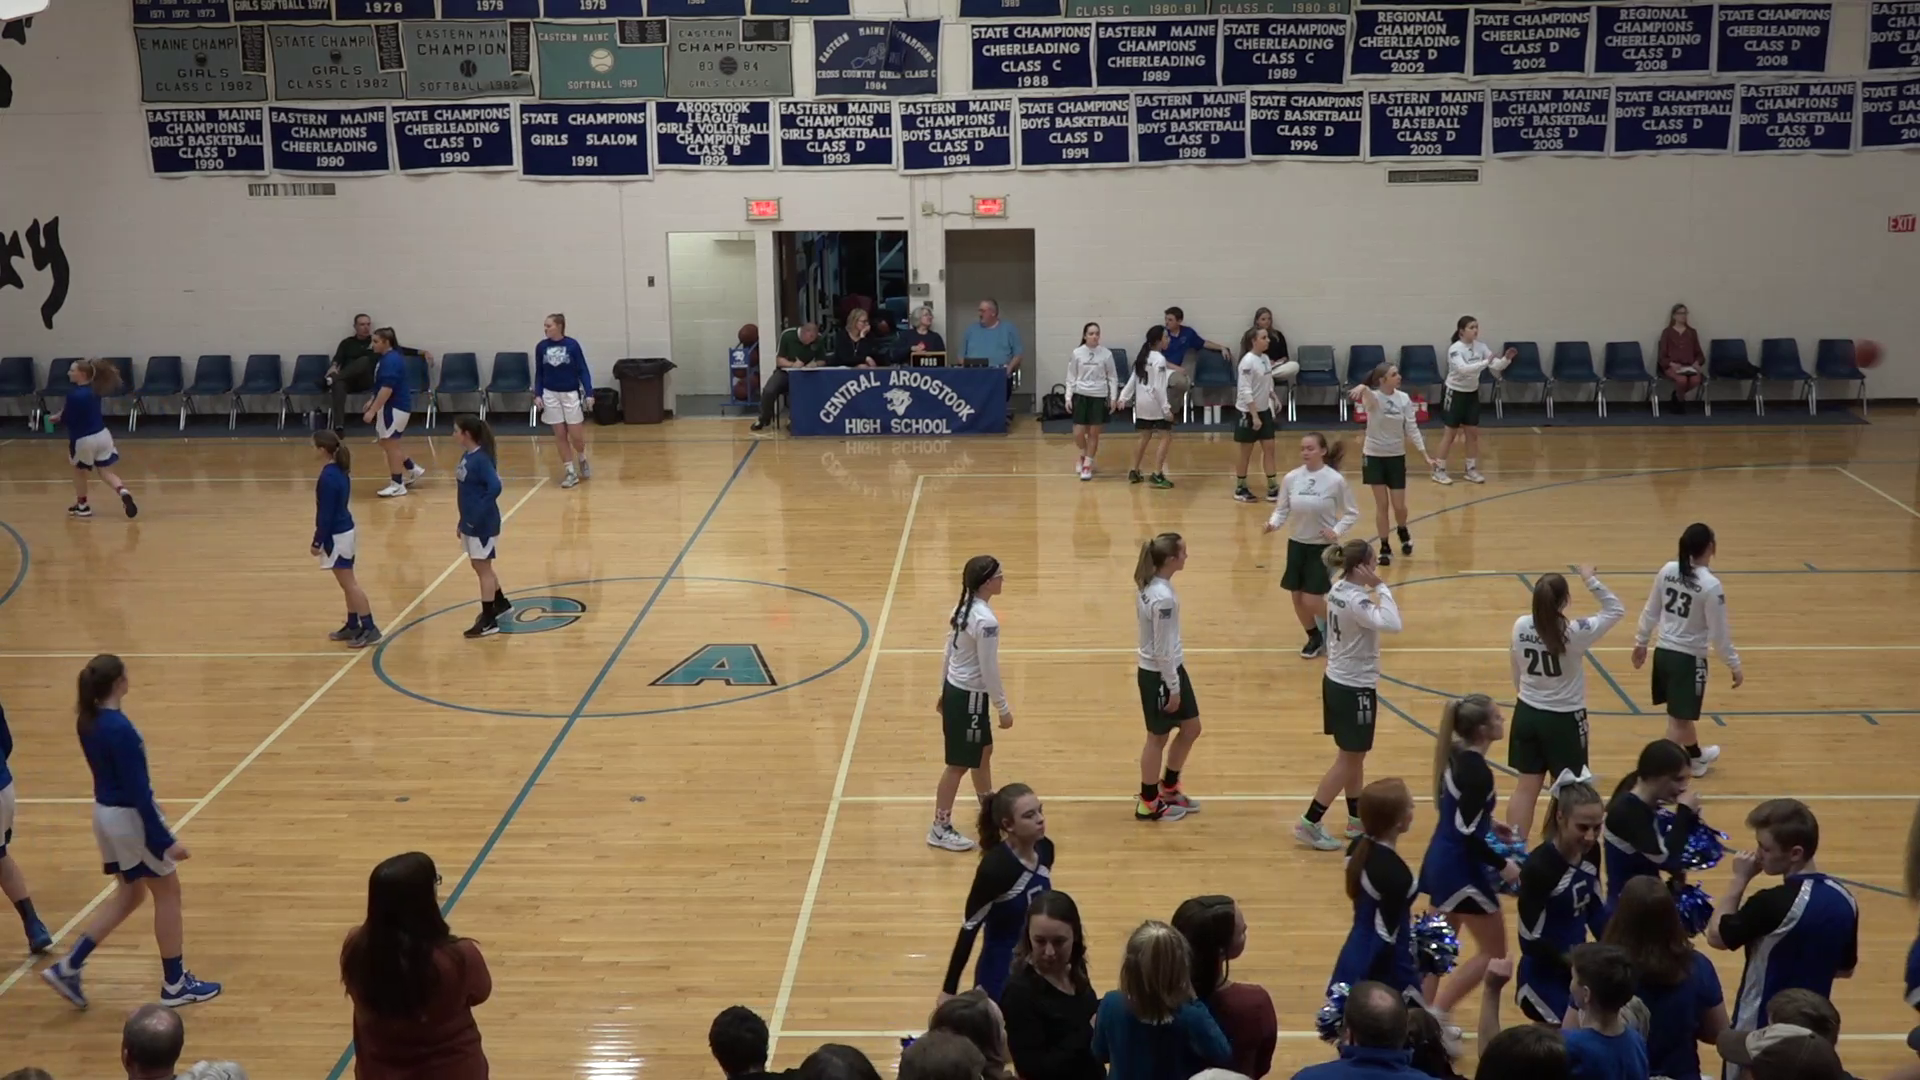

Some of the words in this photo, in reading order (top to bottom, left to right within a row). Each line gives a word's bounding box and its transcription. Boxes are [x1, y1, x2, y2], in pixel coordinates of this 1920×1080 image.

[365, 2, 403, 13] 1978
[1076, 6, 1114, 16] CLASS
[1123, 5, 1130, 15] C
[1220, 3, 1259, 14] CLASS
[1267, 3, 1274, 13] C
[1872, 3, 1920, 15] EASTER
[1378, 12, 1443, 23] REGIONAL
[1620, 9, 1688, 20] REGIONAL
[972, 27, 1009, 39] STATE
[1014, 26, 1090, 38] CHAMPIONS
[1099, 26, 1156, 38] EASTERN
[1170, 25, 1216, 36] MAINE
[1374, 25, 1447, 36] CHAMPION
[1614, 22, 1694, 33] CHAMPIONS
[417, 29, 473, 40] EASTERN
[480, 28, 508, 39] MAIN
[538, 33, 577, 42] EASTERN
[583, 33, 608, 42] MAINE
[1604, 34, 1701, 46] CHEERLEADING
[1871, 30, 1902, 43] BOYS
[152, 39, 188, 50] MAINE
[192, 38, 238, 50] CHAMPI
[276, 36, 315, 47] STATE
[322, 35, 375, 47] CHAMPI
[819, 32, 850, 63] EASTERN
[858, 26, 885, 36] MAINE
[1118, 40, 1196, 52] CHAMPIONS
[1359, 36, 1460, 48] CHEERLEADING
[417, 43, 507, 56] CHAMPION
[982, 43, 1080, 56] CHEERLEADING
[1380, 49, 1419, 60] CLASS
[1428, 49, 1437, 59] D
[1622, 48, 1662, 59] CLASS
[1672, 47, 1682, 58] D
[699, 62, 714, 71] 83
[744, 62, 758, 71] 84
[1001, 61, 1041, 72] CLASS
[1053, 60, 1061, 71] C
[1108, 55, 1205, 68] CHEERLEADING
[1391, 62, 1425, 73] 2002
[1635, 60, 1668, 71] 2008
[177, 68, 229, 78] GIRLS
[312, 66, 362, 75] GIRLS
[817, 70, 840, 78] CROSS
[842, 70, 876, 78] COUNTRY
[905, 70, 928, 78] CLASS
[1142, 71, 1170, 82] 1989
[156, 82, 198, 91] CLASS
[205, 82, 213, 91] C
[220, 81, 252, 91] 1982
[287, 80, 332, 89] CLASS
[340, 80, 347, 88] C
[356, 79, 388, 88] 1982
[420, 81, 483, 92] SOFTBALL
[489, 80, 519, 91] 1982
[568, 81, 612, 89] SOFTBALL
[619, 80, 638, 88] 1983
[689, 80, 719, 88] GIRLS
[1018, 76, 1049, 86] 1988
[1615, 91, 1653, 102] STATE
[1658, 90, 1734, 101] CHAMPIONS
[1740, 85, 1799, 97] EASTERN
[1809, 84, 1854, 95] MAINE
[1862, 86, 1898, 98] STATE
[1136, 95, 1192, 106] EASTERN
[1203, 92, 1246, 104] MAINE
[1370, 94, 1430, 105] EASTERN
[1441, 91, 1484, 103] MAINE
[1755, 98, 1838, 110] CHAMPIONS
[676, 102, 750, 113] AROOSTOOK
[901, 103, 956, 114] EASTERN
[968, 101, 1011, 112] MAINE
[1386, 106, 1468, 117] CHAMPIONS
[1615, 106, 1645, 118] BOYS
[1652, 105, 1732, 117] BASKETBALL
[1862, 102, 1893, 112] BOYS
[148, 110, 206, 122] EASTERN
[218, 109, 262, 121] MAINE
[271, 111, 327, 124] EASTERN
[340, 111, 385, 123] MAINE
[522, 113, 558, 124] STATE
[568, 112, 645, 124] CHAMPIONS
[688, 113, 738, 124] LEAGUE
[1152, 107, 1231, 120] CHAMPIONS
[1740, 114, 1769, 124] BOYS
[1777, 112, 1852, 123] BASKETBALL
[1889, 114, 1920, 125] CLAS
[916, 115, 995, 127] CHAMPIONS
[1392, 118, 1460, 129] BASEBALL
[1642, 119, 1683, 130] CLASS
[1693, 118, 1703, 129] D
[166, 122, 245, 134] CHAMPIONS
[291, 126, 367, 139] CHAMPIONS
[657, 123, 692, 134] GIRLS
[697, 123, 770, 134] VOLLEYBALL
[1137, 123, 1167, 134] BOYS
[1170, 121, 1245, 134] BASKETBALL
[1766, 126, 1806, 136] CLASS
[1814, 125, 1824, 135] D
[530, 134, 568, 146] GIRLS
[586, 134, 638, 146] SLALOM
[676, 135, 750, 145] CHAMPIONS
[902, 130, 931, 142] BOYS
[934, 126, 1010, 140] BASKETBALL
[1164, 134, 1202, 145] CLASS
[1211, 134, 1220, 144] D
[1396, 131, 1438, 141] CLASS
[1446, 130, 1455, 141] D
[1655, 134, 1687, 145] 2005
[150, 136, 184, 148] GIRLS
[188, 134, 264, 146] BASKETBALL
[281, 140, 378, 154] CHEERLEADING
[928, 141, 968, 152] CLASS
[975, 140, 984, 151] D
[1778, 138, 1810, 147] 2006
[178, 147, 218, 159] CLASS
[228, 146, 237, 158] D
[687, 145, 725, 156] CLASS
[734, 145, 741, 155] B
[1178, 148, 1206, 158] 1996
[1410, 144, 1442, 154] 2003
[195, 159, 224, 170] 1990
[316, 156, 345, 167] 1990
[572, 156, 598, 167] 1991
[700, 156, 728, 166] 1992
[943, 155, 970, 166] 1994
[1890, 216, 1915, 232] EXIT
[820, 371, 880, 423] CENTRAL
[889, 370, 975, 422] AROOSTOOK
[845, 419, 880, 434] HIGH
[891, 419, 951, 434] SCHOOL
[1665, 587, 1692, 619] 23
[1519, 633, 1544, 644] SAUC
[647, 644, 778, 686] A
[1524, 648, 1562, 677] 20
[1358, 695, 1370, 710] 14
[971, 716, 978, 729] 2
